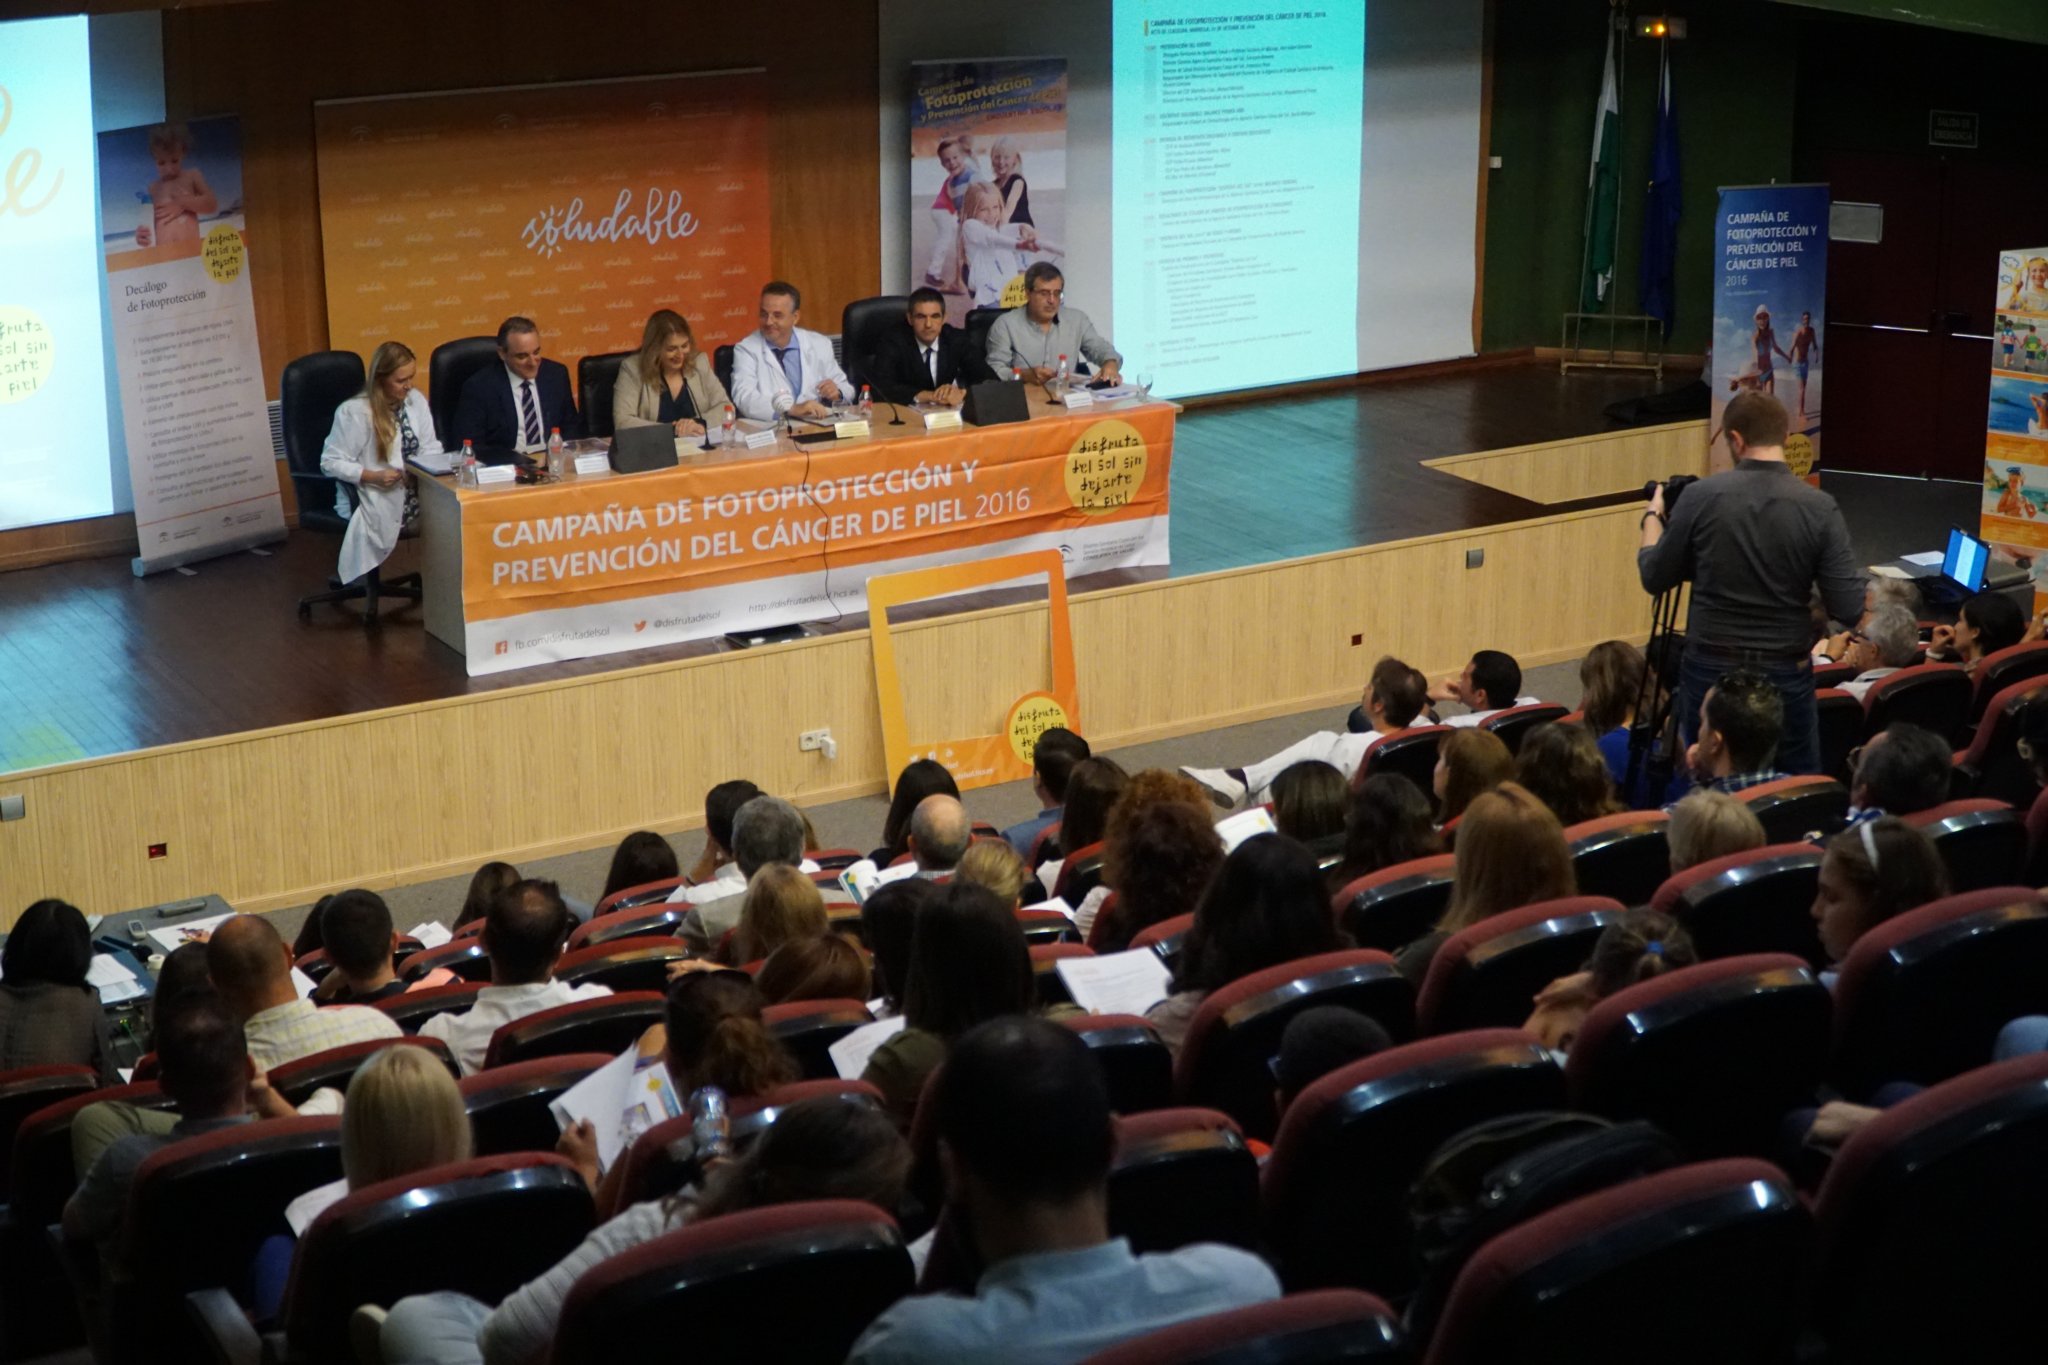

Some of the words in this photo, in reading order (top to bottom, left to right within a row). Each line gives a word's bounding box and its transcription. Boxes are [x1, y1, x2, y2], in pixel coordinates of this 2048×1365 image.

[925, 76, 1032, 109] Fotoprotección
[521, 187, 699, 253] soludable
[1727, 210, 1775, 225] CAMPAÑA
[1777, 211, 1790, 222] DE
[1726, 224, 1809, 240] FOTOPROTECCIÓN
[1810, 225, 1818, 236] Y
[1726, 240, 1785, 256] PREVENCIÓN
[1786, 241, 1803, 253] DEL
[1726, 257, 1764, 271] CÁNCER
[1765, 257, 1778, 268] DE
[1780, 256, 1798, 268] PIEL
[125, 279, 167, 296] Decálogo
[1725, 275, 1748, 287] 2016
[127, 301, 139, 313] de
[140, 289, 207, 310] Fotoprotección
[1078, 434, 1140, 456] disfruta
[1072, 459, 1092, 474] del
[1098, 457, 1116, 472] sol
[1124, 456, 1142, 468] sin
[1080, 474, 1133, 494] dejarte
[492, 503, 647, 549] CAMPAÑA
[656, 498, 692, 528] DE
[703, 461, 952, 521] FOTOPROTECCIÓN
[961, 459, 979, 484] Y
[1081, 496, 1095, 509] la
[1103, 491, 1129, 509] piel
[492, 537, 681, 586] PREVENCIÓN
[691, 530, 744, 561] DEL
[751, 513, 863, 551] CÁNCER
[871, 506, 906, 534] DE
[914, 498, 967, 527] PIEL
[975, 487, 1031, 519] 2016
[654, 610, 721, 630] @disfrutadelsol
[1018, 708, 1061, 722] disfruta
[1014, 725, 1028, 735] del
